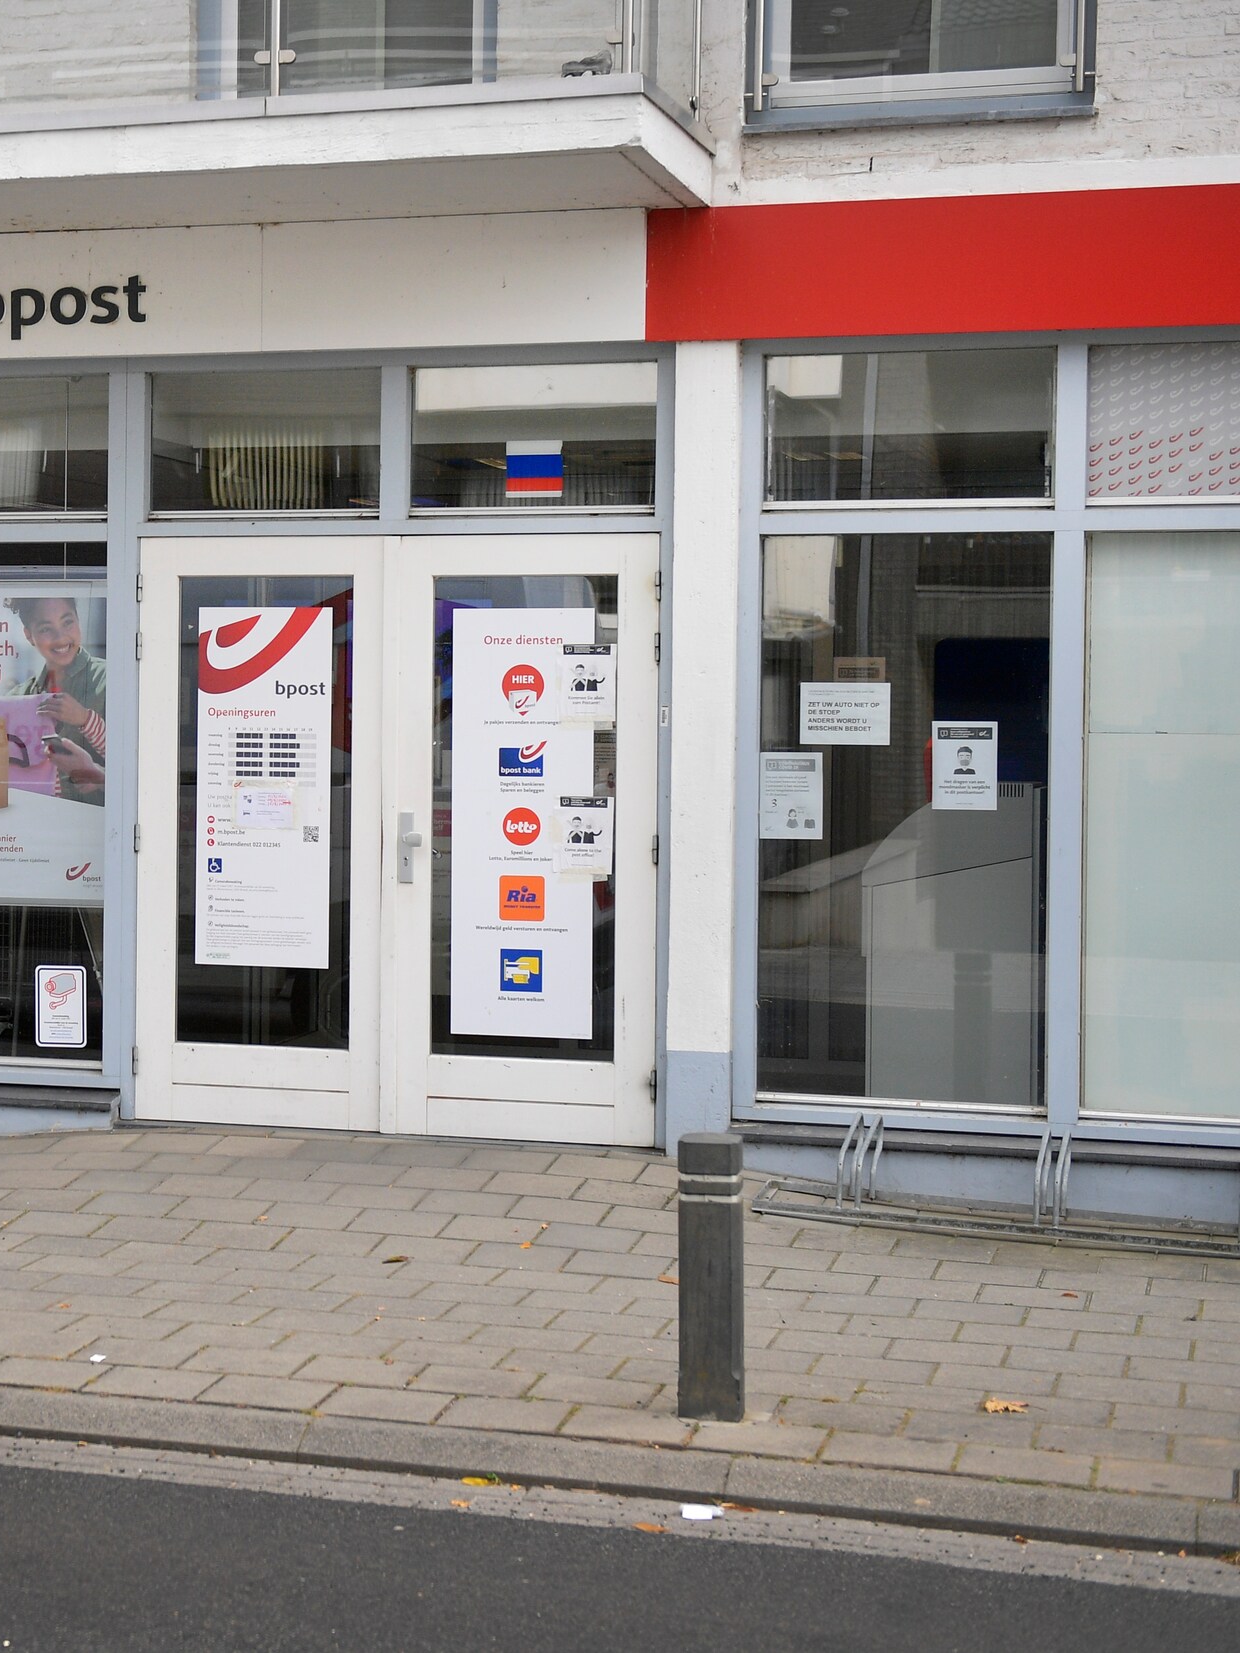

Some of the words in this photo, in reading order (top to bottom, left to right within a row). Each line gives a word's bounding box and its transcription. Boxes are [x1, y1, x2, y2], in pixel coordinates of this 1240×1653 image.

[484, 635, 512, 645] Onze
[516, 634, 564, 645] diensten
[511, 675, 535, 684] HIER
[275, 681, 326, 699] bpost
[207, 707, 276, 719] Openingsuren
[500, 767, 521, 775] bpost
[506, 820, 537, 833] Lotto
[506, 885, 537, 903] Ria
